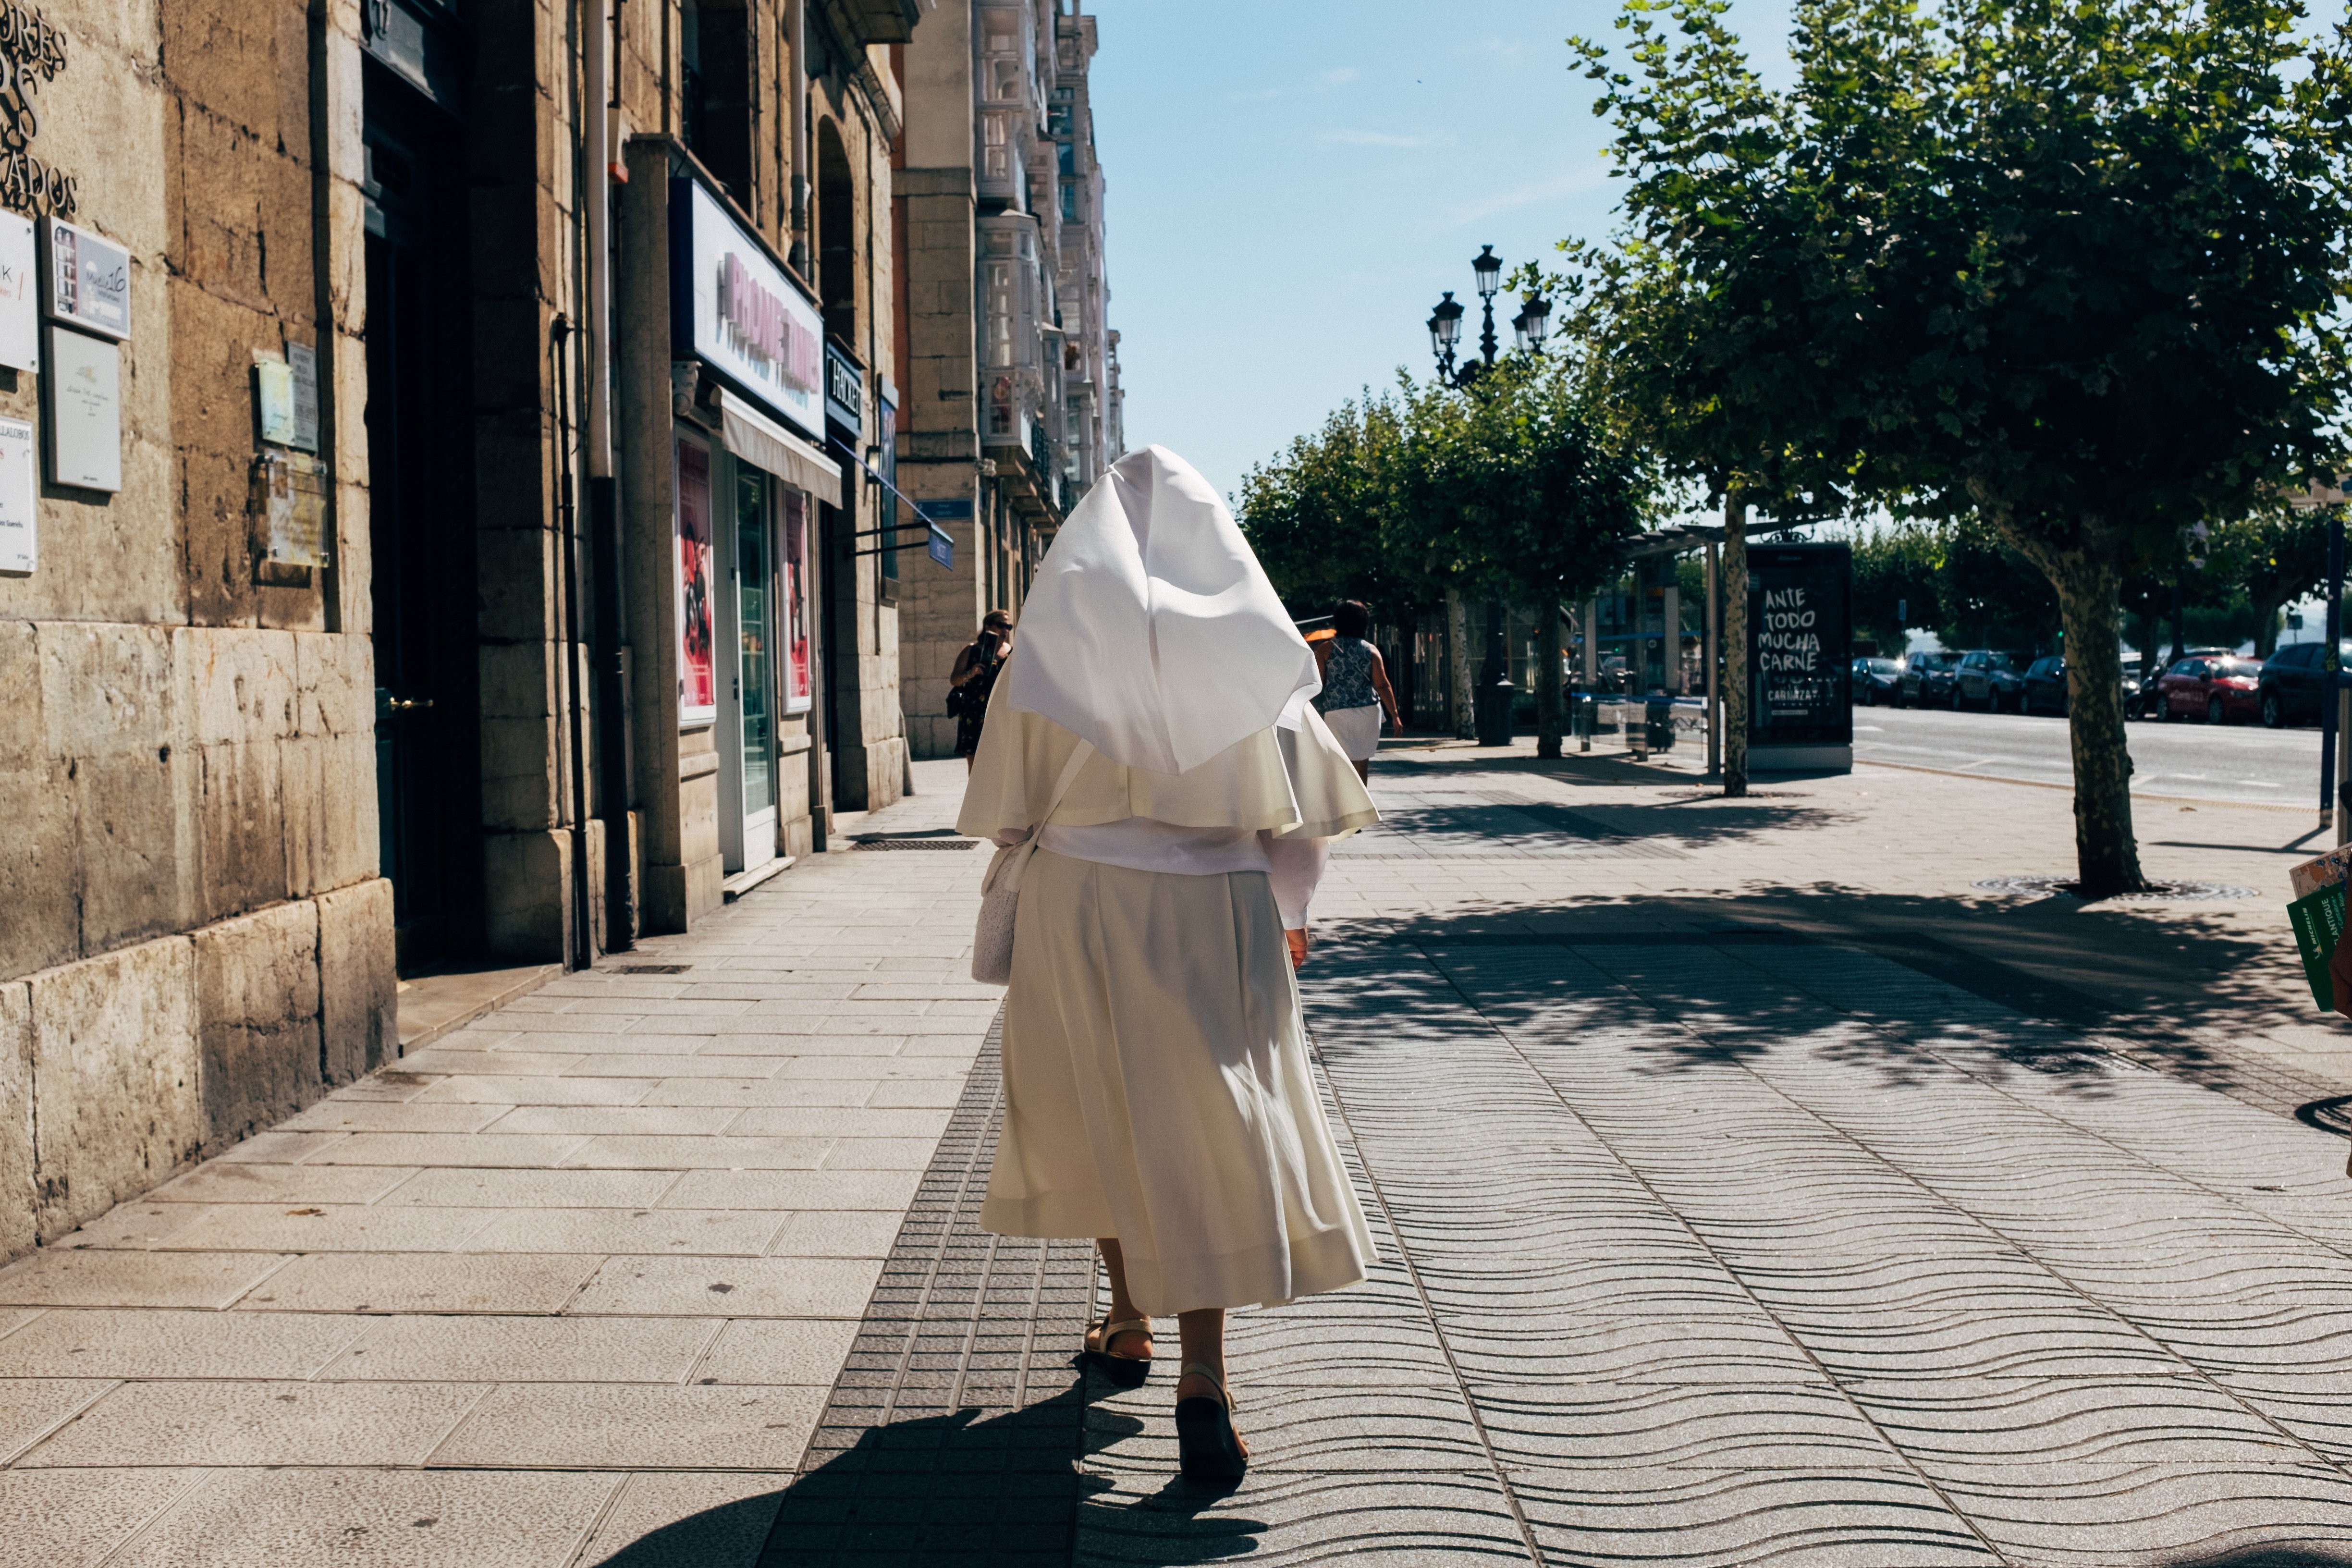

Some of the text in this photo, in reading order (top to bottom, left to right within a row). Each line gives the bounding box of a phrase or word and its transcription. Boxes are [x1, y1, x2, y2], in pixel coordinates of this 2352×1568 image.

[1766, 587, 1806, 609] ANTE
[1764, 610, 1815, 632] TODO
[1758, 632, 1820, 652] MUCHA
[1760, 651, 1817, 672] CARNE
[2303, 907, 2317, 944] MICHELIN
